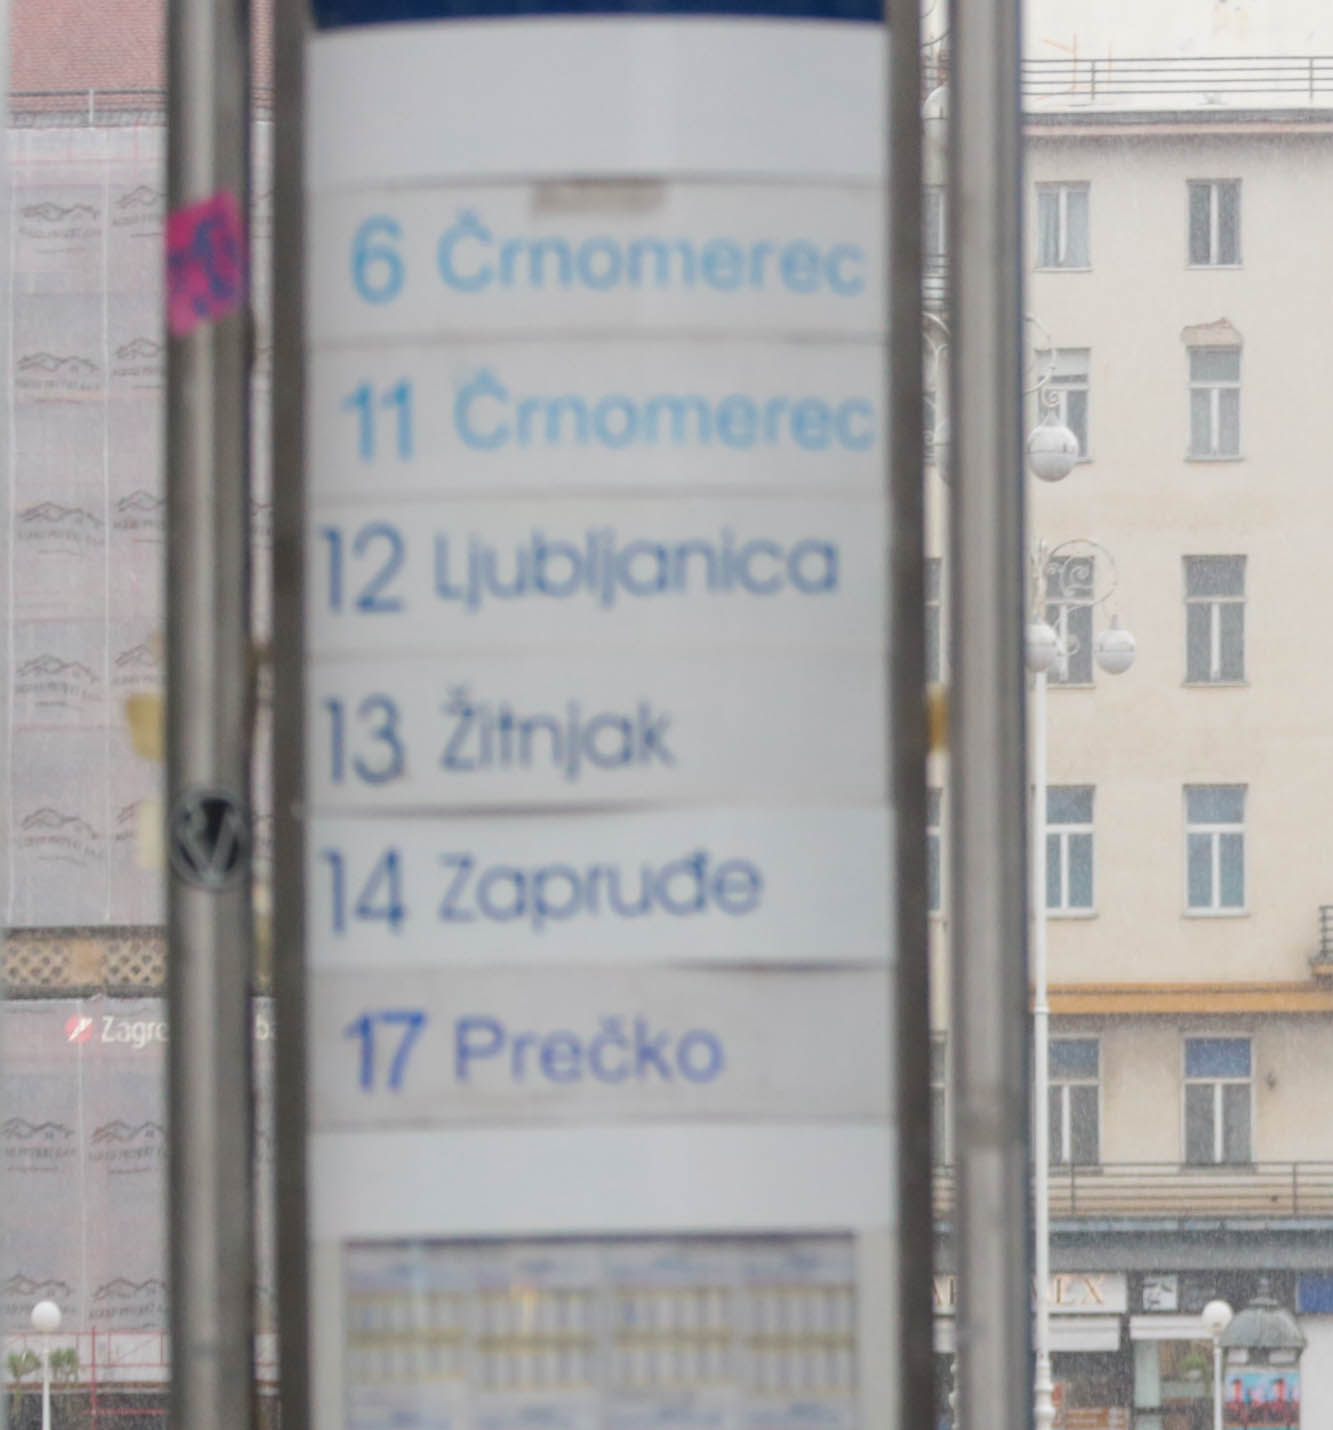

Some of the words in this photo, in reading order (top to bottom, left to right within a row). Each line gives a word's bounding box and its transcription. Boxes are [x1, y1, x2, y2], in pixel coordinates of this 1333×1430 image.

[349, 214, 406, 305] 6
[434, 208, 869, 298] Črnomerec
[341, 377, 414, 464] 11
[452, 368, 877, 453] Črnomerec
[320, 521, 406, 614] 12
[433, 526, 842, 612] Ljubljanica
[321, 692, 406, 787] 13
[438, 683, 676, 782] Žitnjak
[318, 846, 407, 936] 14
[344, 1009, 428, 1092] 17
[453, 1014, 726, 1084] Prečko
